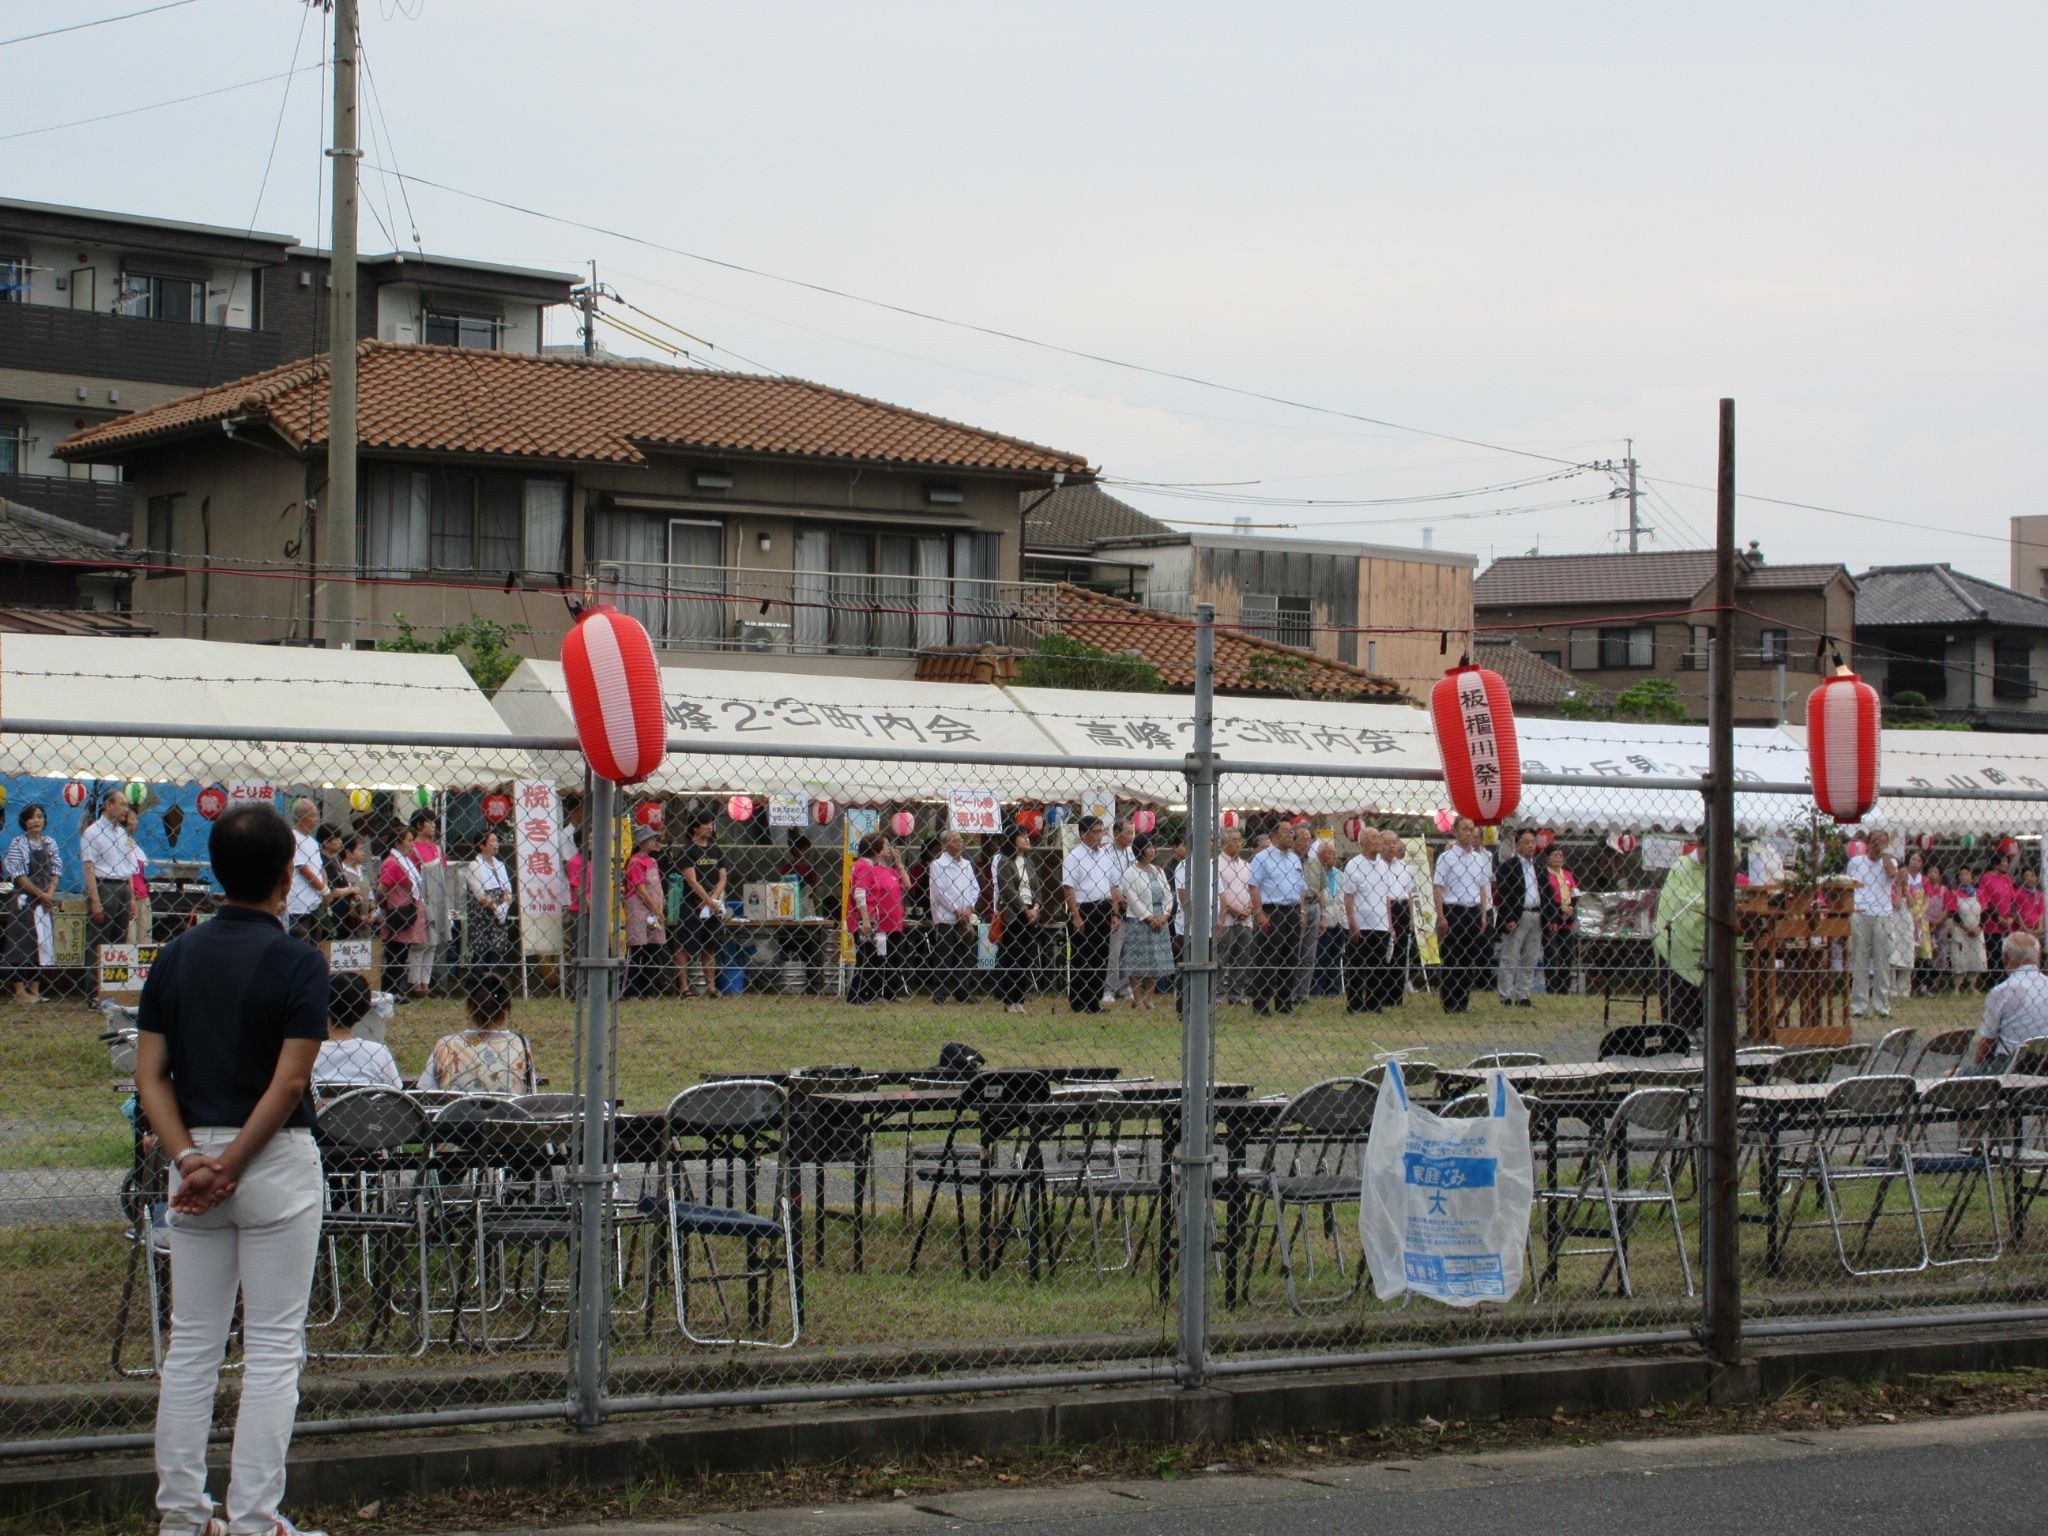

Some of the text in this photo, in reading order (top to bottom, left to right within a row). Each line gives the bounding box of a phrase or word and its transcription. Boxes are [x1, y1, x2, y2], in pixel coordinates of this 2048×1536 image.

[523, 784, 553, 876] 焼き鳥
[1428, 1191, 1448, 1215] 大
